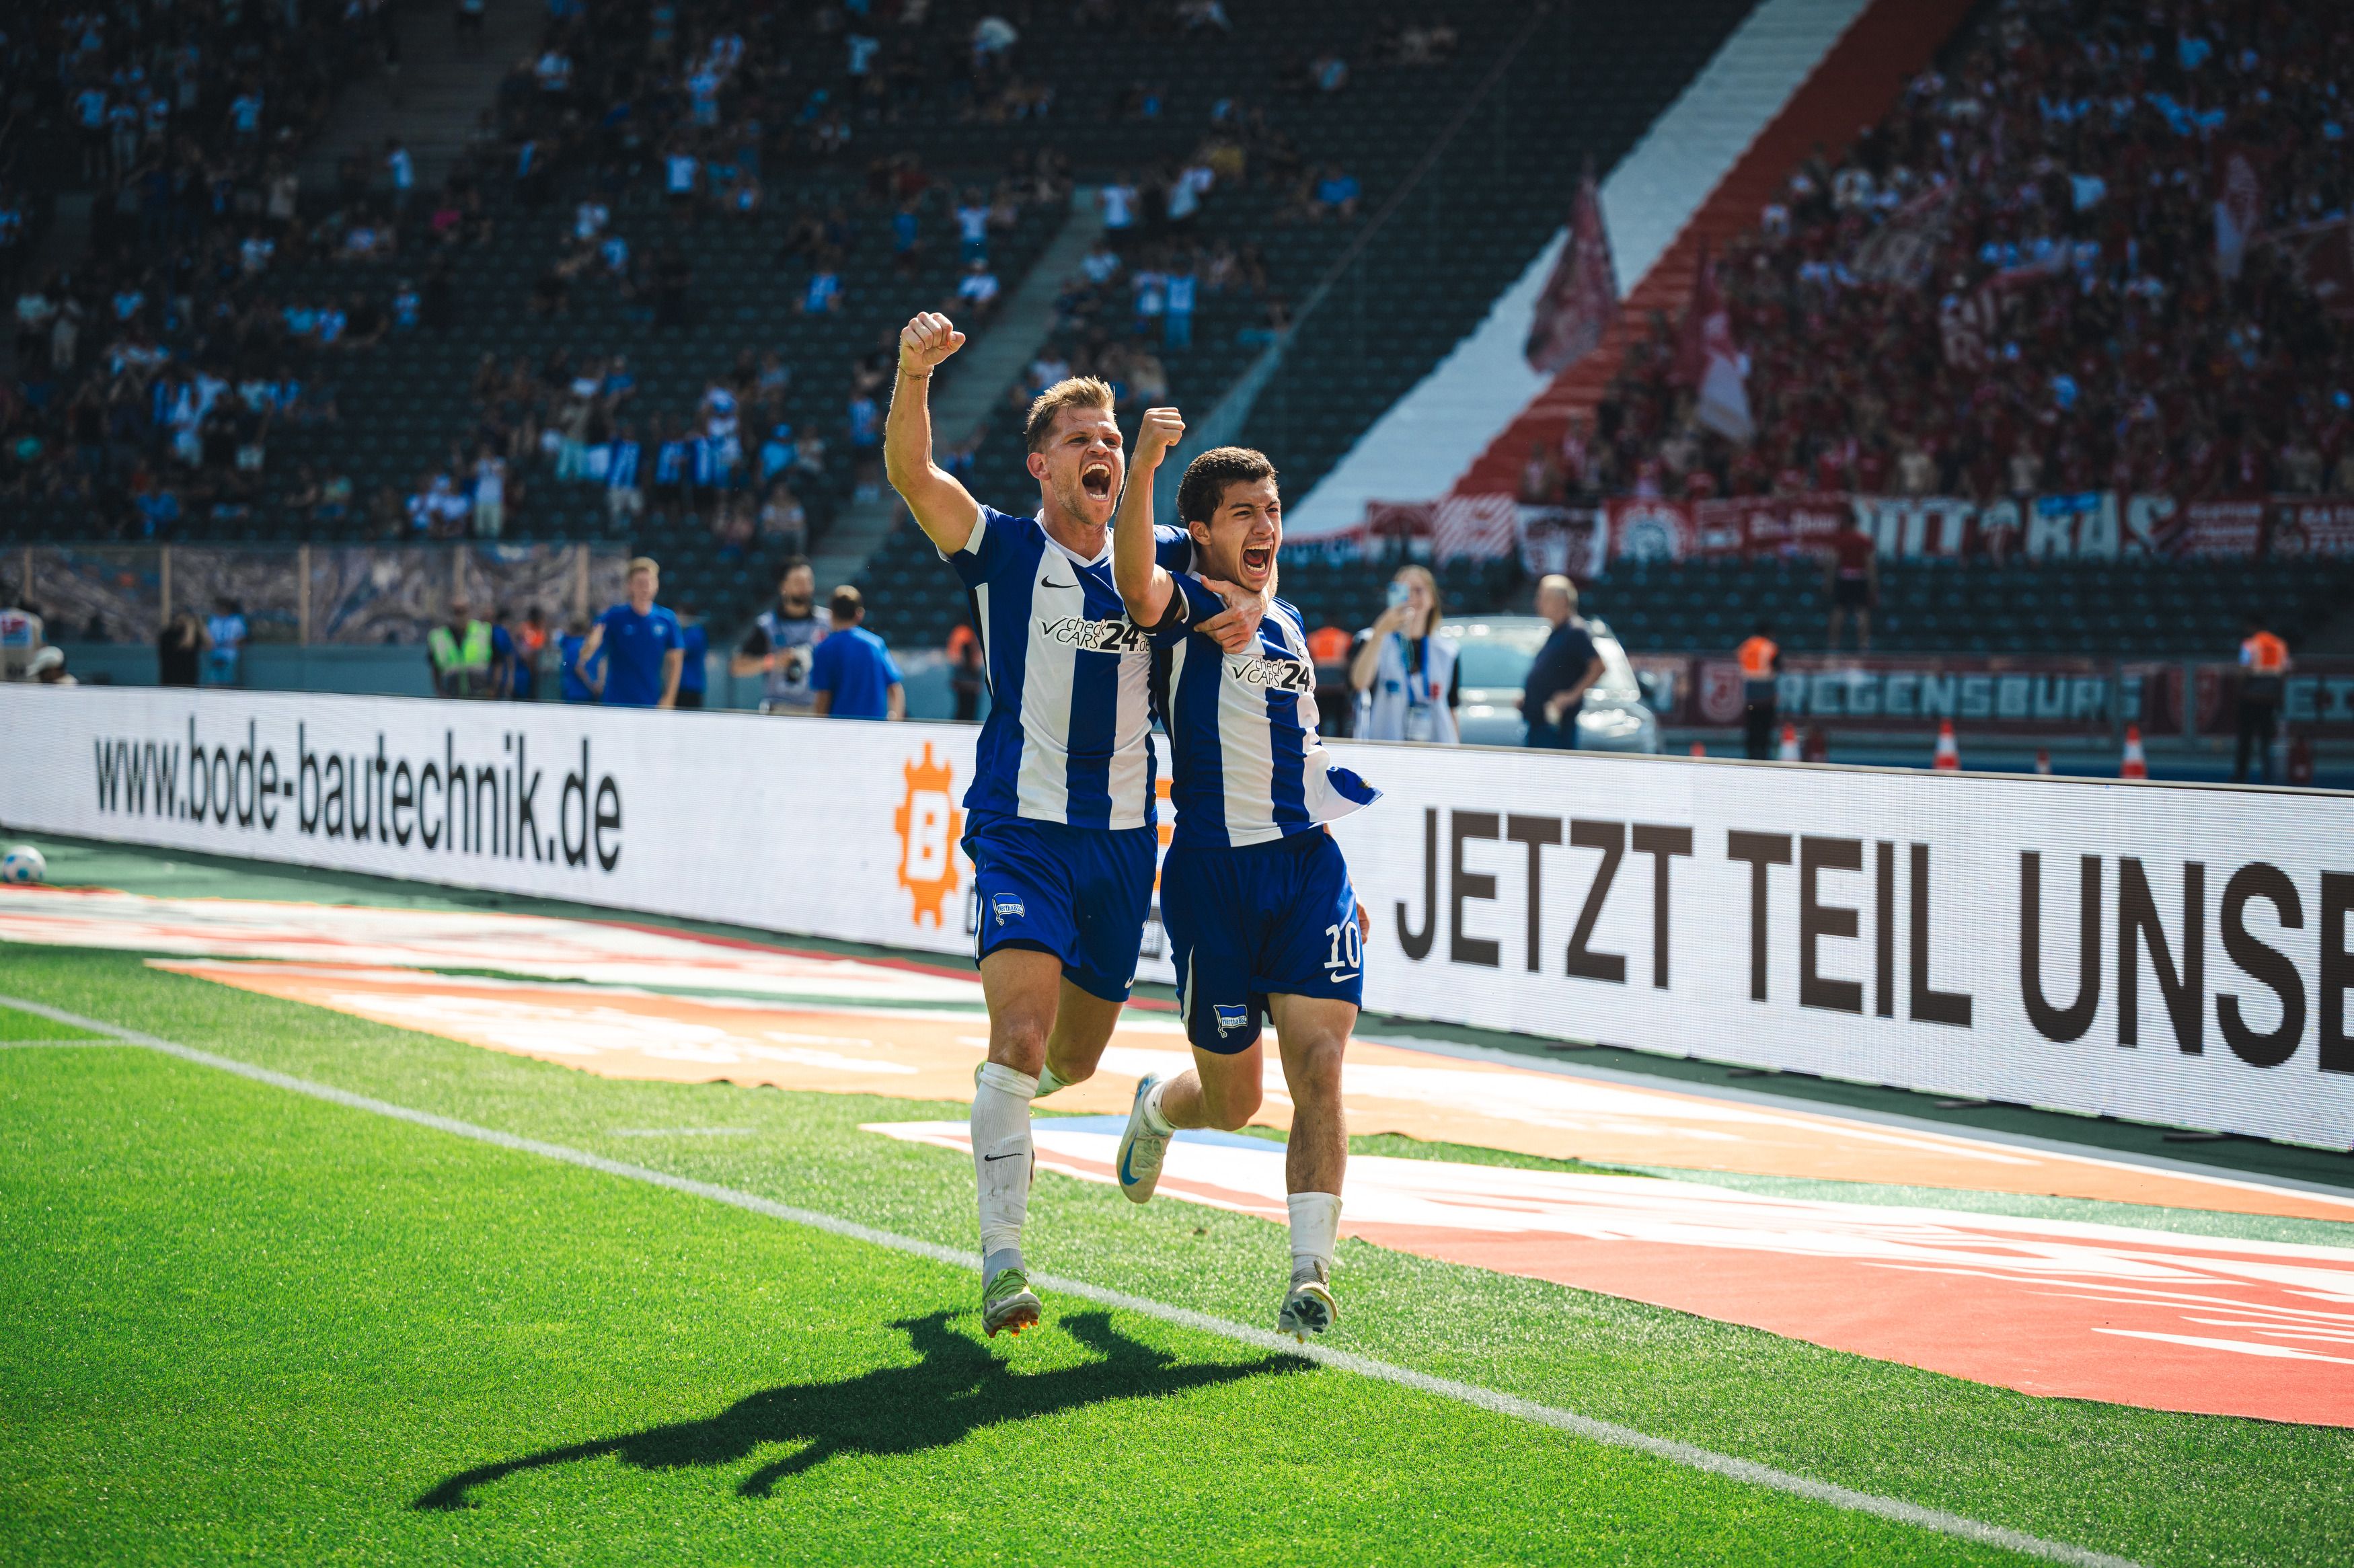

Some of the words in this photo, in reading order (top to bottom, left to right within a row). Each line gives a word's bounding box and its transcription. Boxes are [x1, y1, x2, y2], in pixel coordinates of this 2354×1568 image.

[1067, 617, 1105, 636] check
[1056, 628, 1100, 650] CARS
[1248, 669, 1280, 687] CARS
[1255, 658, 1284, 676] check
[95, 715, 622, 872] www.bode-bautechnik.de
[1396, 807, 1693, 990] JETZT
[1727, 828, 1972, 1027] TEIL
[1324, 921, 1361, 969] 10
